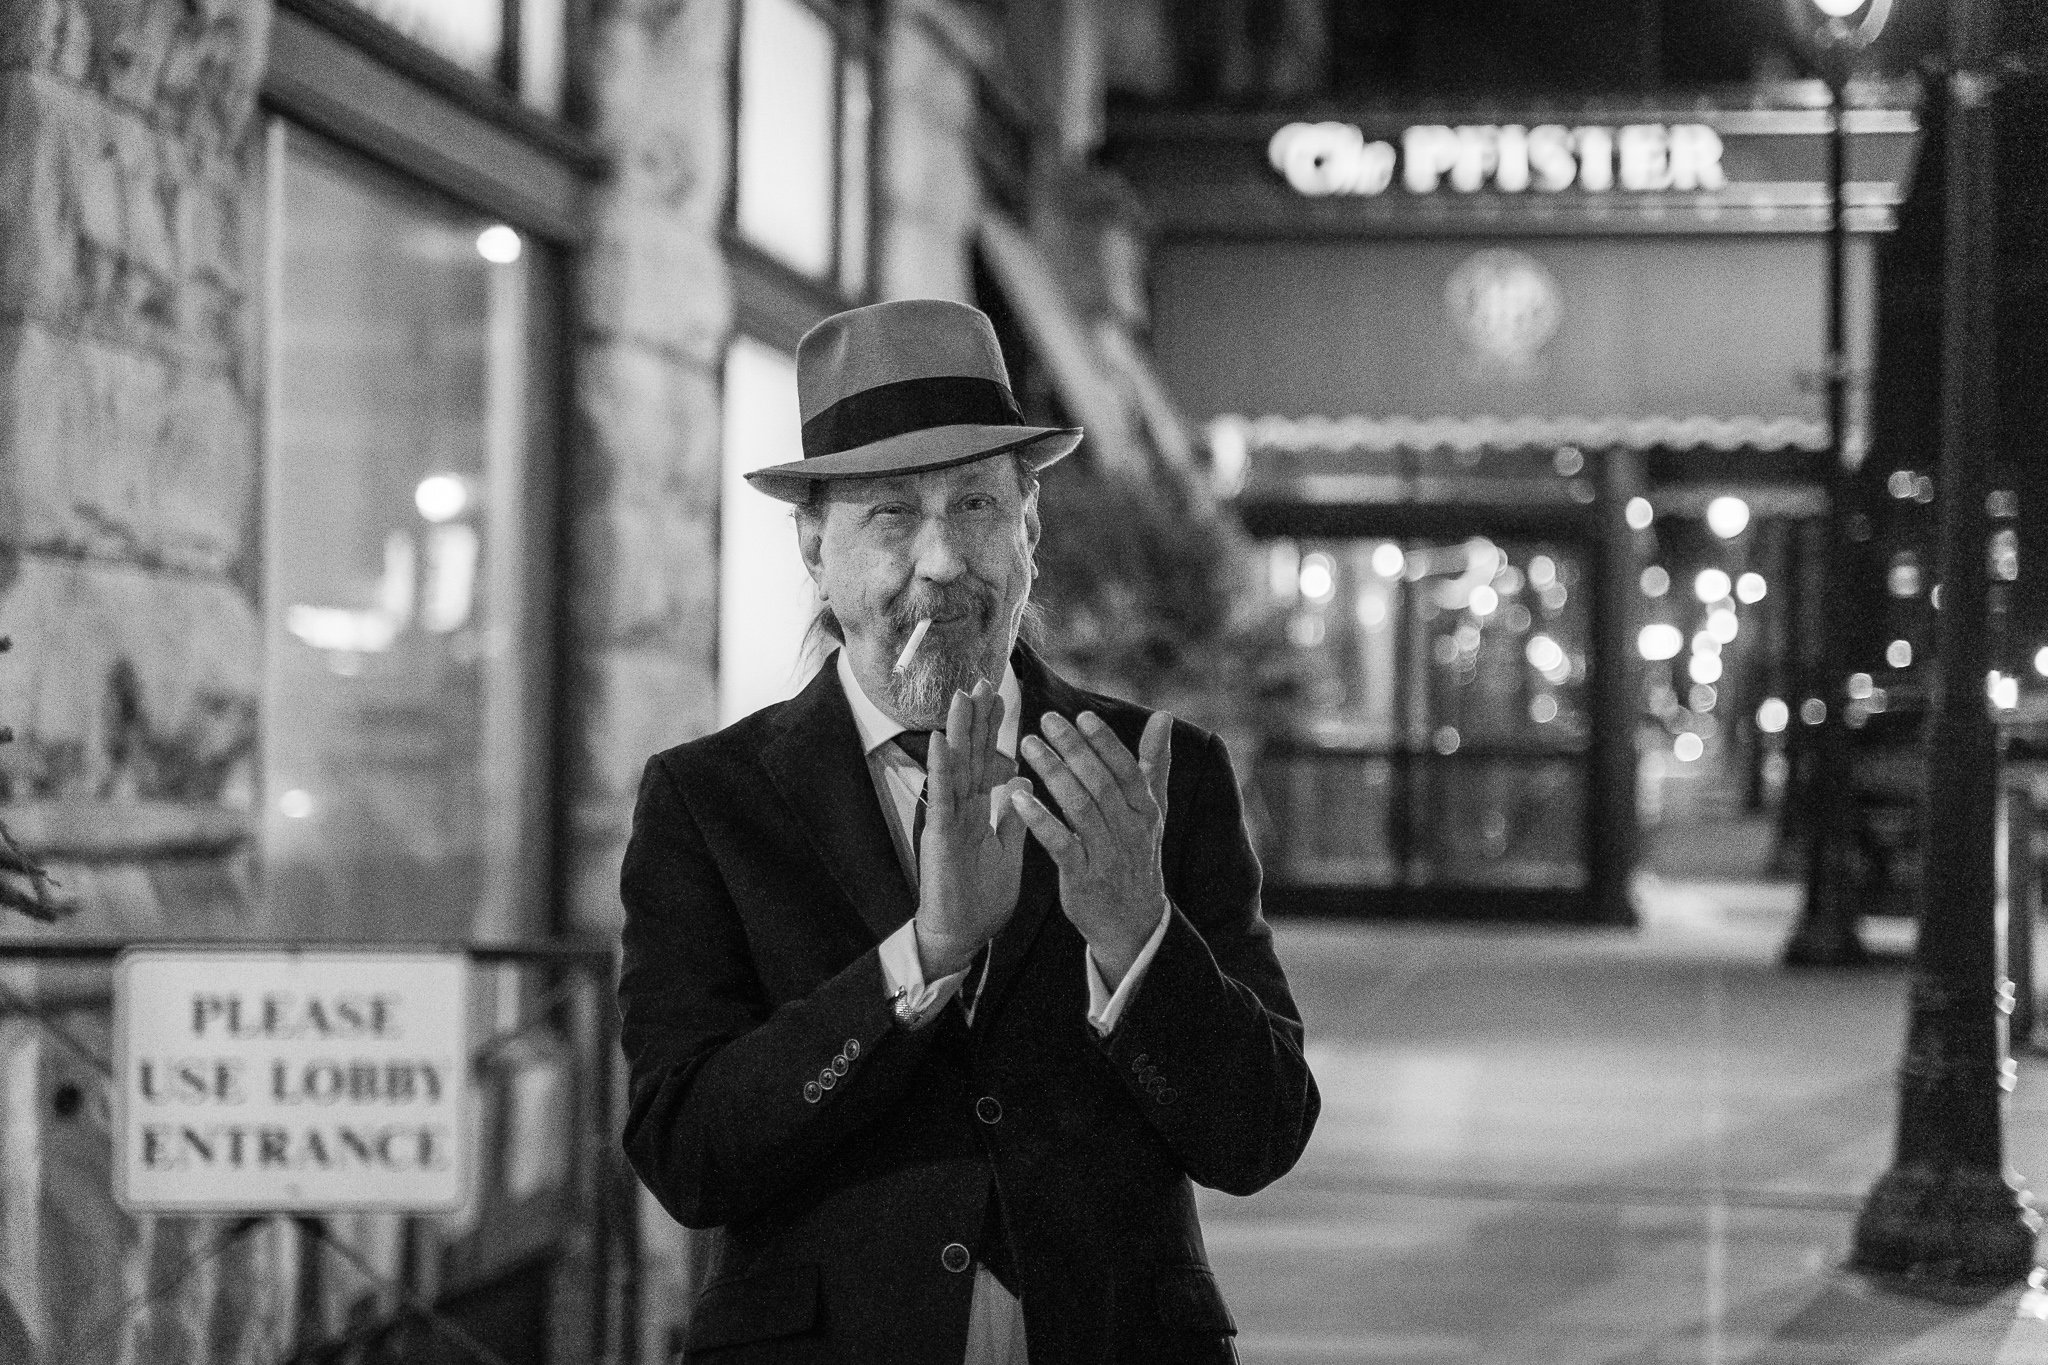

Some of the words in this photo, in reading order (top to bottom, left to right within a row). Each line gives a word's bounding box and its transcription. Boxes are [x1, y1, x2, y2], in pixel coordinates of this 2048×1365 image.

[1403, 123, 1724, 193] PFISTER
[191, 994, 401, 1040] PLEASE
[140, 1057, 247, 1105] USE
[270, 1057, 445, 1105] LOBBY
[142, 1122, 448, 1171] ENTRANCE
